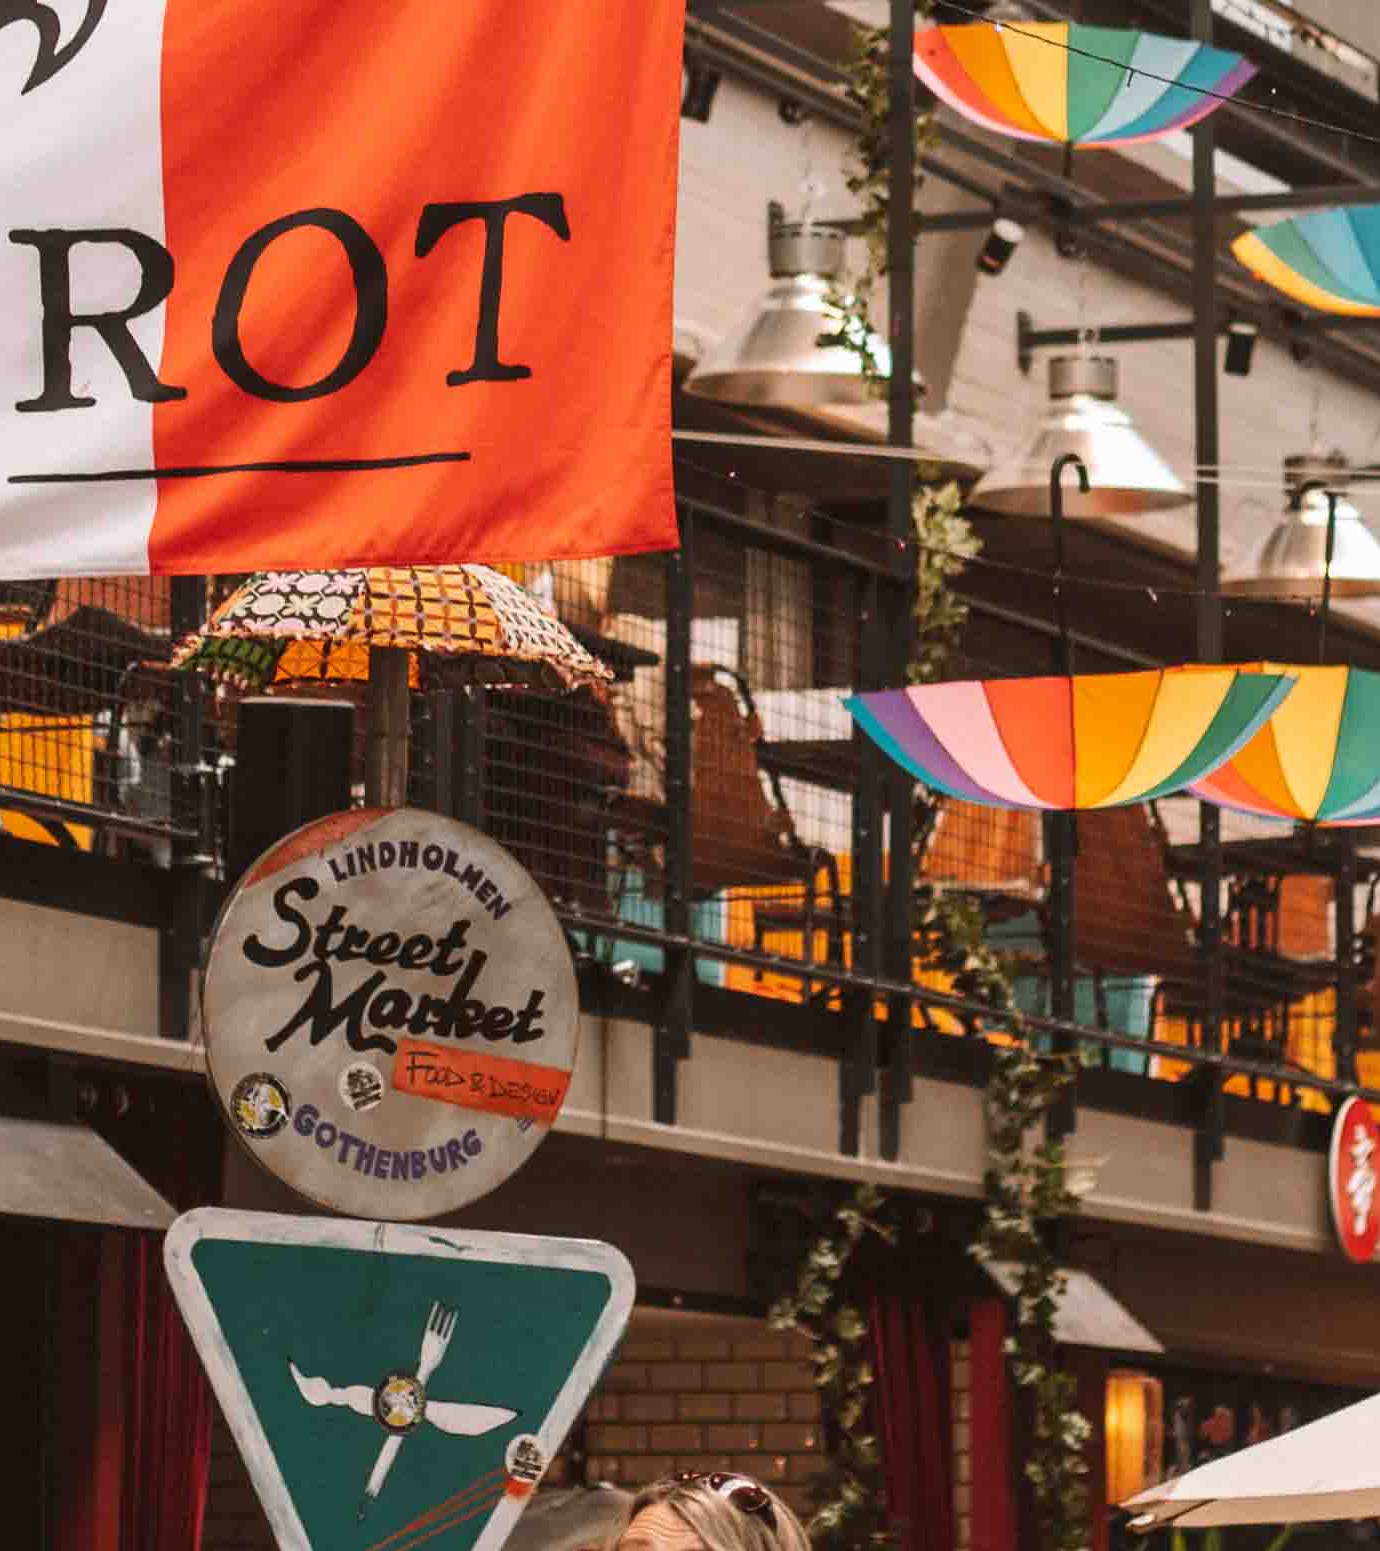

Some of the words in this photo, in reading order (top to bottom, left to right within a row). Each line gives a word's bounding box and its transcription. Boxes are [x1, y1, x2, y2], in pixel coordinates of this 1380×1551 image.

[327, 840, 512, 921] LINDHOLMEN
[243, 877, 471, 976] Street
[264, 950, 546, 1054] Market
[470, 1072, 485, 1092] &
[489, 1074, 562, 1105] DESIGN
[292, 1103, 483, 1180] GOTHENBURG
